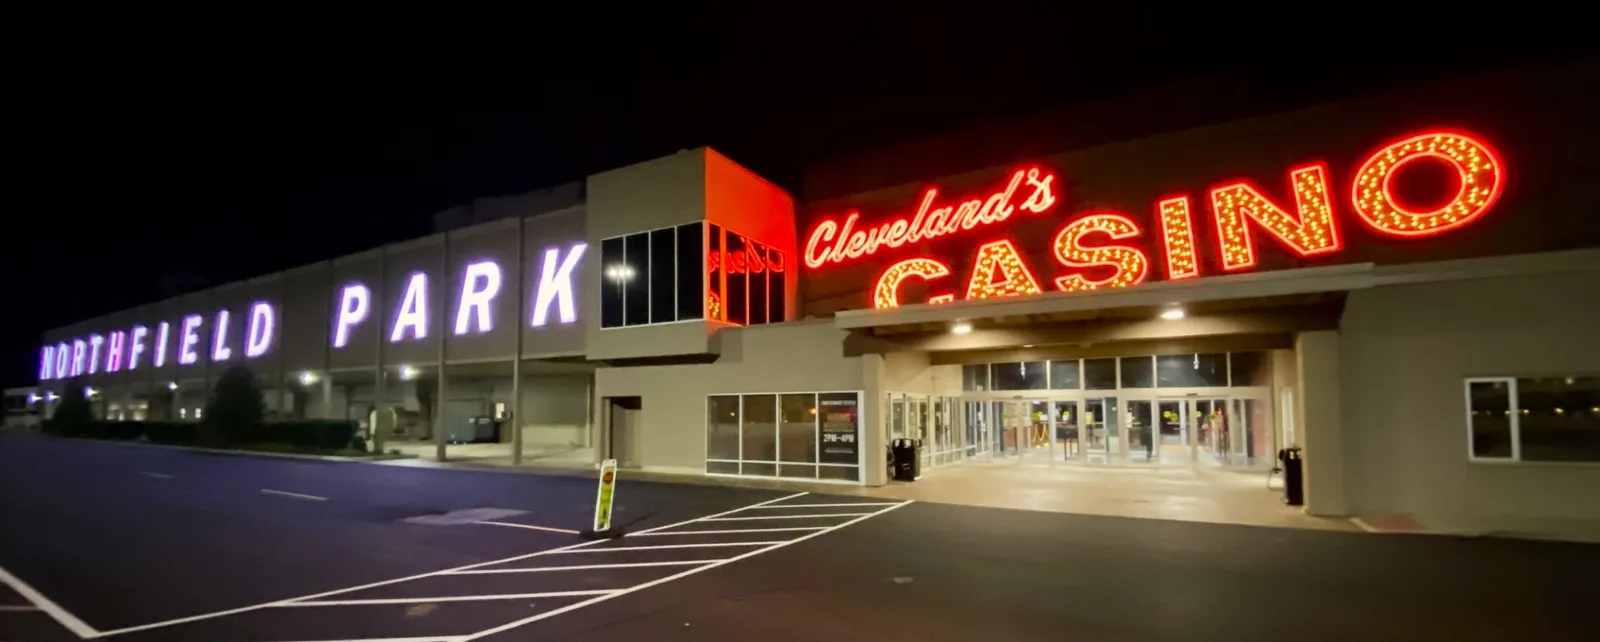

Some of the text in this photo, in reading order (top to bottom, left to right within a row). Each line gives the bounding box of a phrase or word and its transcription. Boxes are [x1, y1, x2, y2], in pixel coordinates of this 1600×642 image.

[804, 167, 1055, 268] Cleveland's
[873, 132, 1500, 310] CASINO
[40, 243, 588, 380] NORTHFIELD PARK
